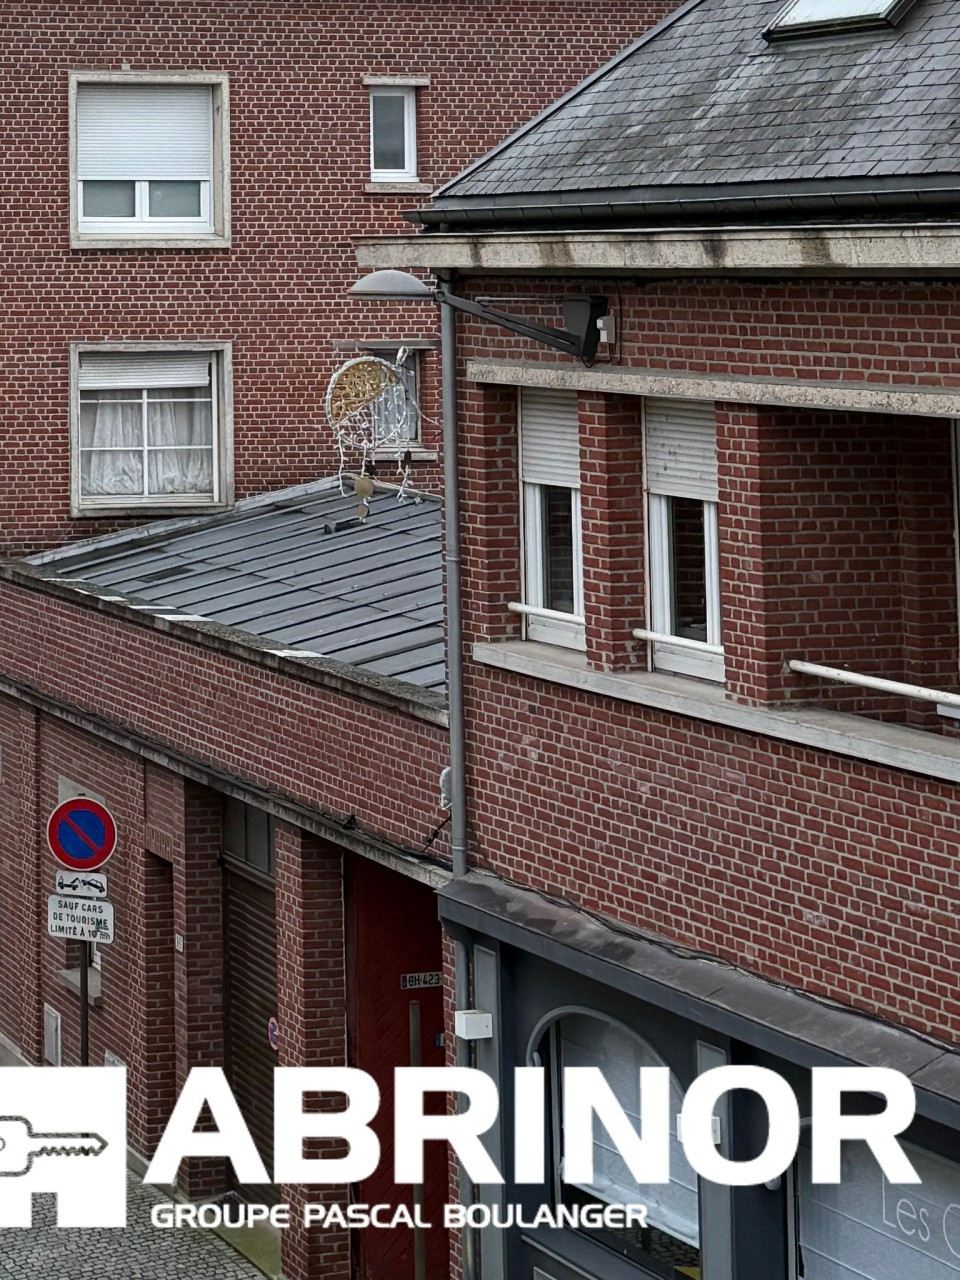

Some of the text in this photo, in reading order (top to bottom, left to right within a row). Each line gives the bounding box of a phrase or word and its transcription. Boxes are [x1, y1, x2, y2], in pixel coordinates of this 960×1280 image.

[58, 900, 104, 914] SAUF CARS
[53, 912, 108, 928] DE TOURISME
[50, 924, 77, 936] LIMITÉ
[88, 929, 97, 938] 10
[882, 1171, 930, 1242] Les
